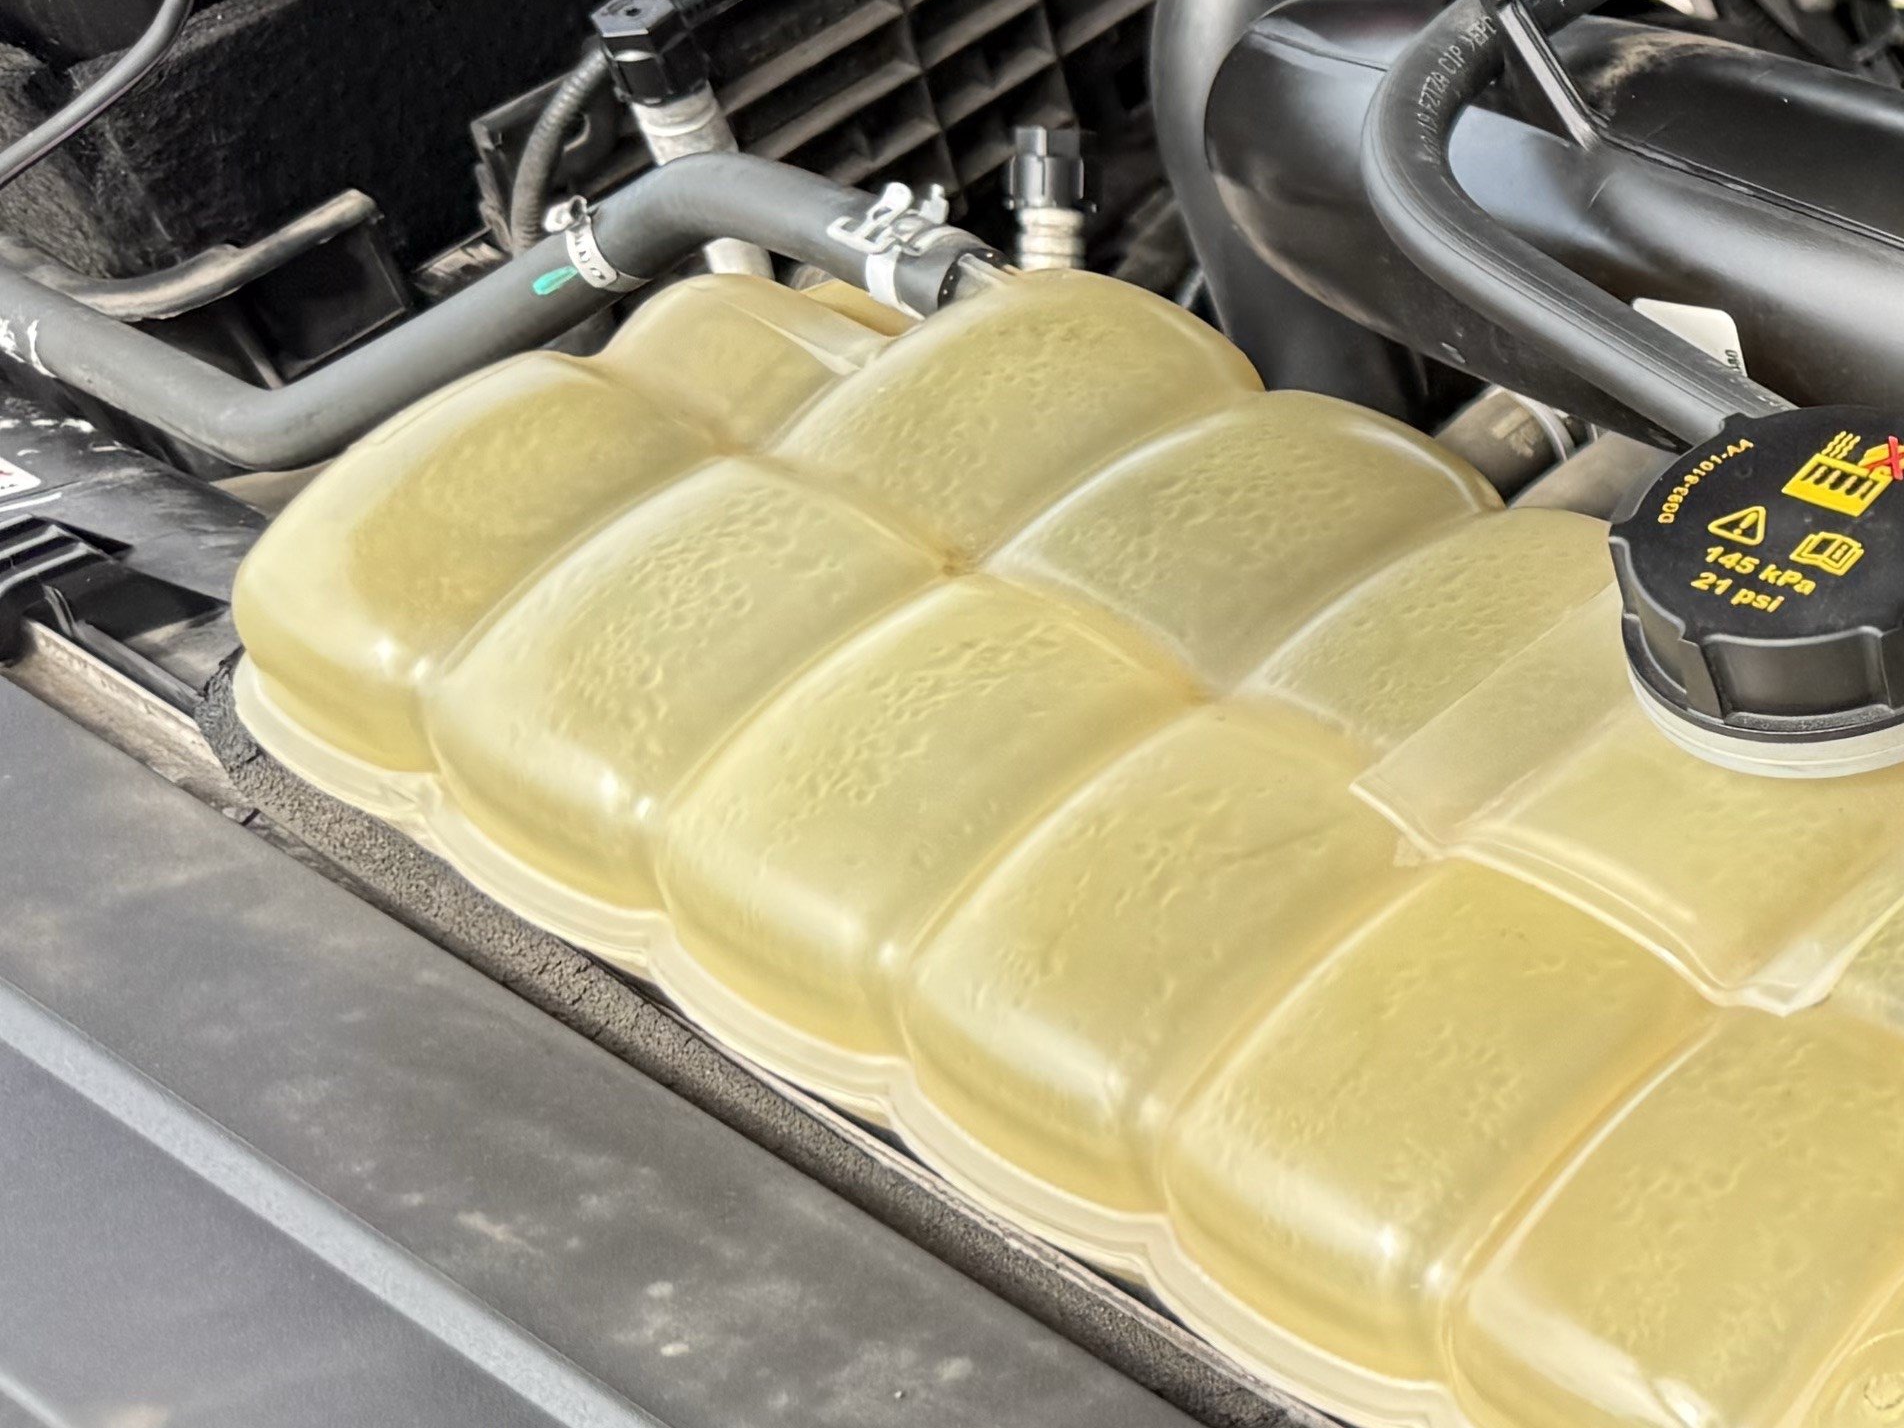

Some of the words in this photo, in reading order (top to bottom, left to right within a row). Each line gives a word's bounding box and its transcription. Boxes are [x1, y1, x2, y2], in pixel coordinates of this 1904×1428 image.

[1691, 572, 1733, 595] 21
[1731, 588, 1785, 613] psi
[1705, 545, 1760, 574] 145
[1758, 564, 1816, 595] kPa
